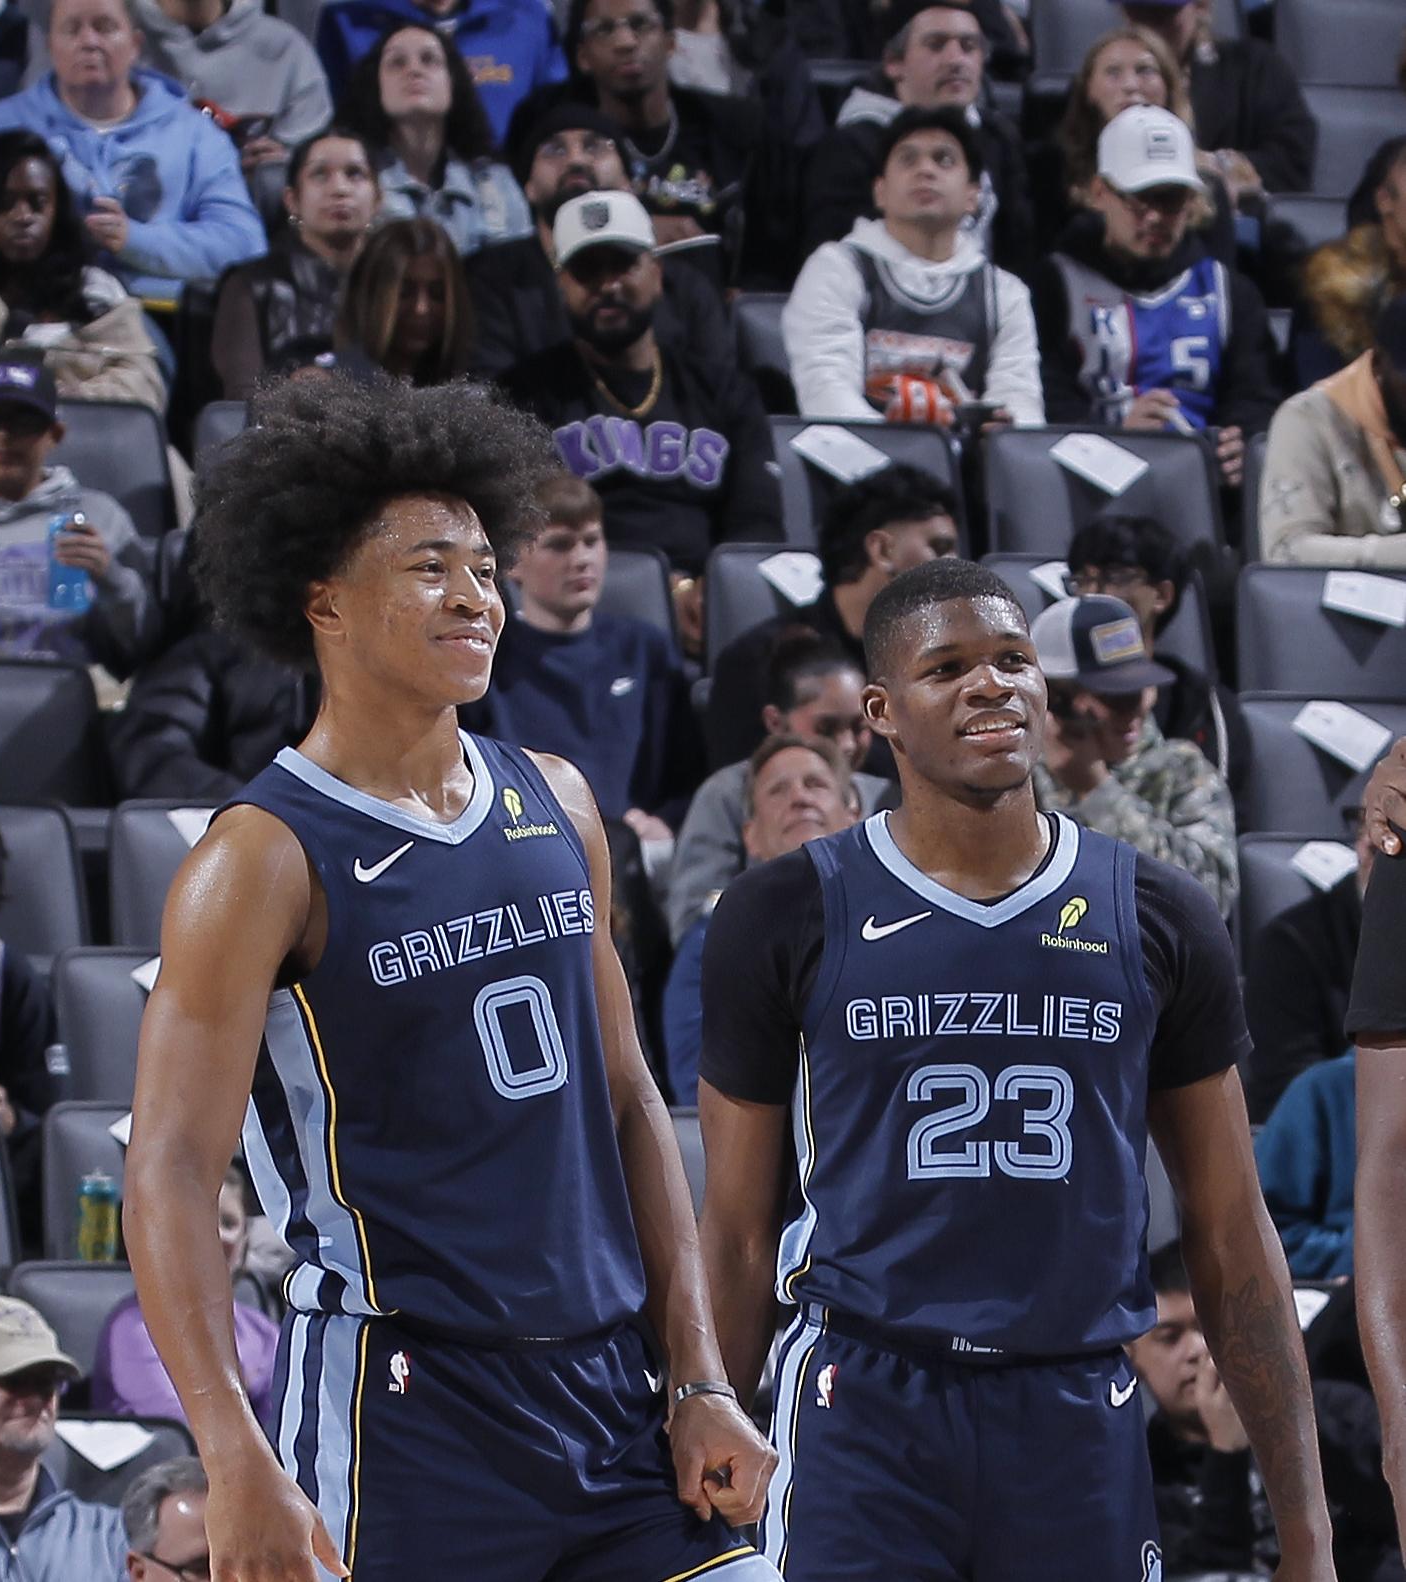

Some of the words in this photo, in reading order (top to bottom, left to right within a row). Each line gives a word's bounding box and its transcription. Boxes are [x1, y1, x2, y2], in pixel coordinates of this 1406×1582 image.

[1170, 335, 1210, 392] 5
[552, 414, 731, 490] KINGS
[503, 822, 559, 841] Robinhood
[368, 889, 595, 987] GRIZZLIES
[1041, 933, 1108, 954] Robinhood
[473, 974, 569, 1101] 0
[845, 993, 1123, 1044] GRIZZLIES
[906, 1063, 1075, 1181] 23
